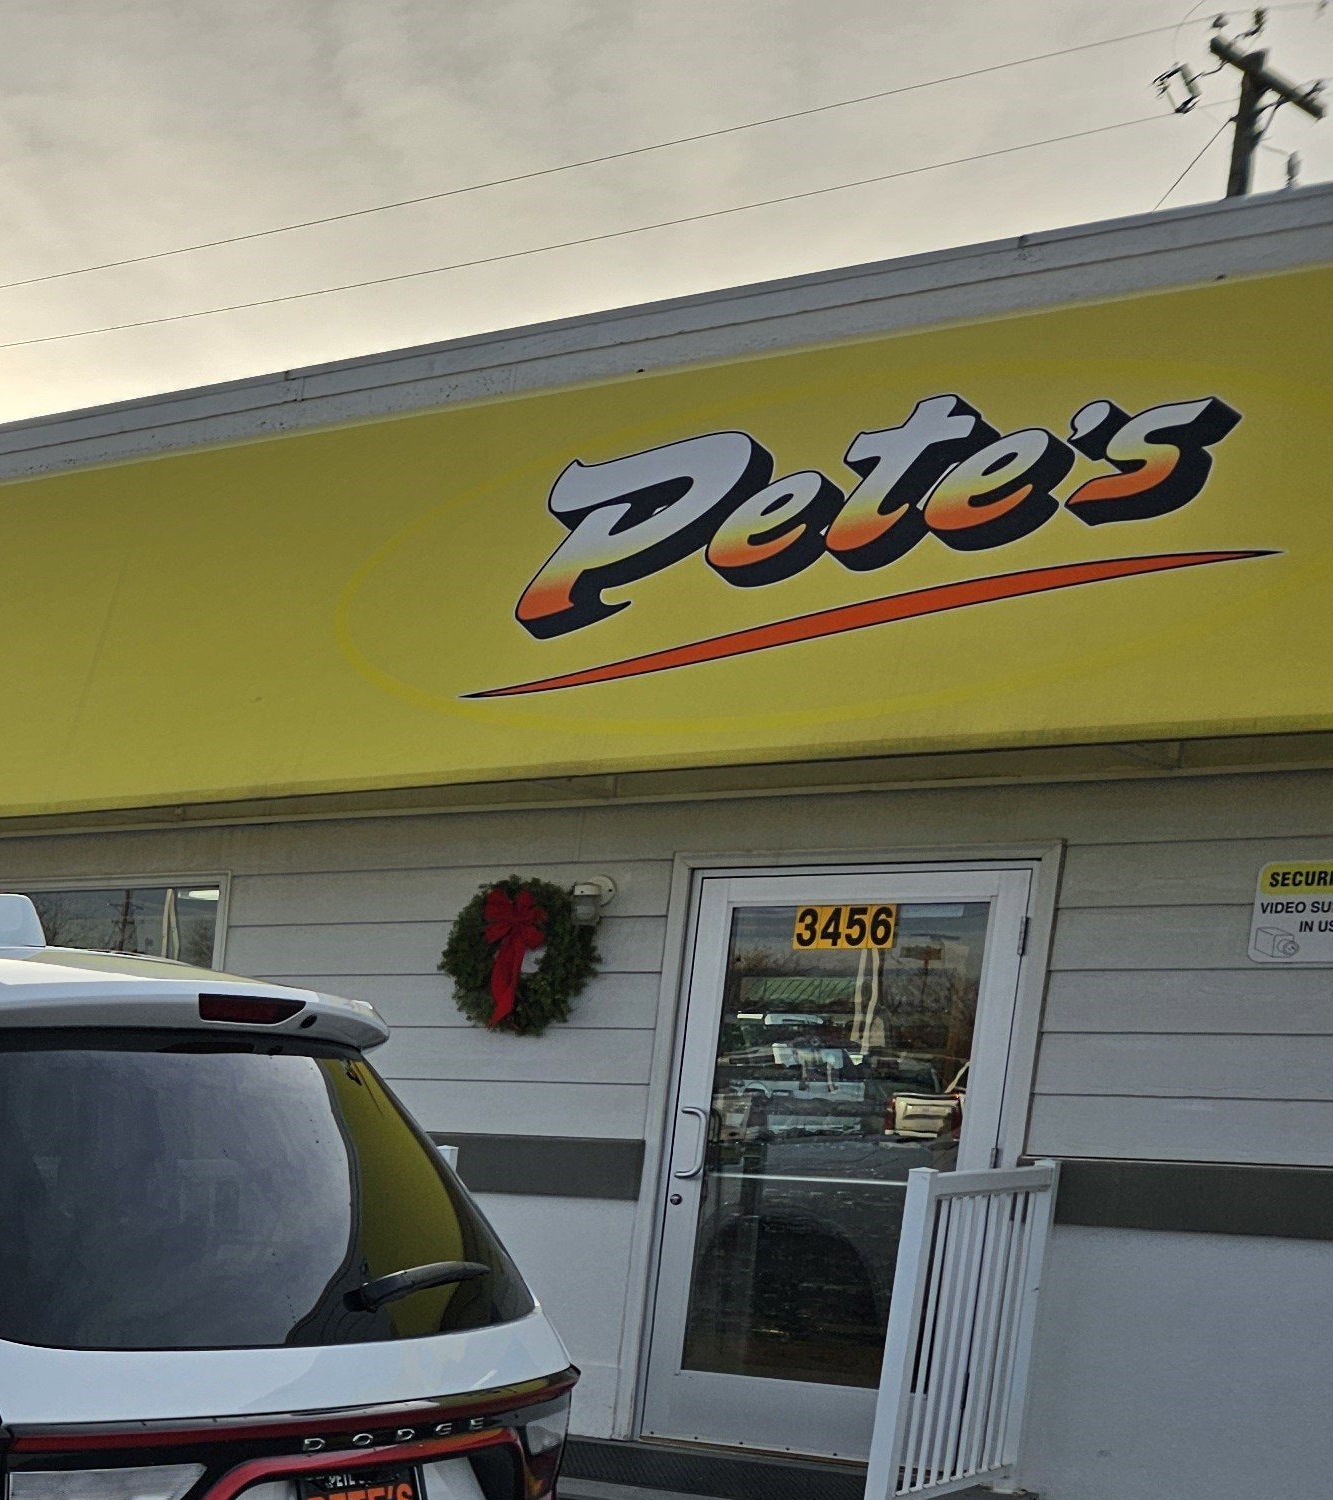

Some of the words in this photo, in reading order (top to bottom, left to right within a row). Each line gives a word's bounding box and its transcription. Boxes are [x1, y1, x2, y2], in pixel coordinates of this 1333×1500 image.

[514, 394, 1242, 639] Pete's
[1260, 901, 1307, 914] VIDEO
[1310, 901, 1333, 913] SU
[796, 906, 893, 947] 3456
[1298, 920, 1315, 933] IN
[303, 1417, 485, 1451] DODGE
